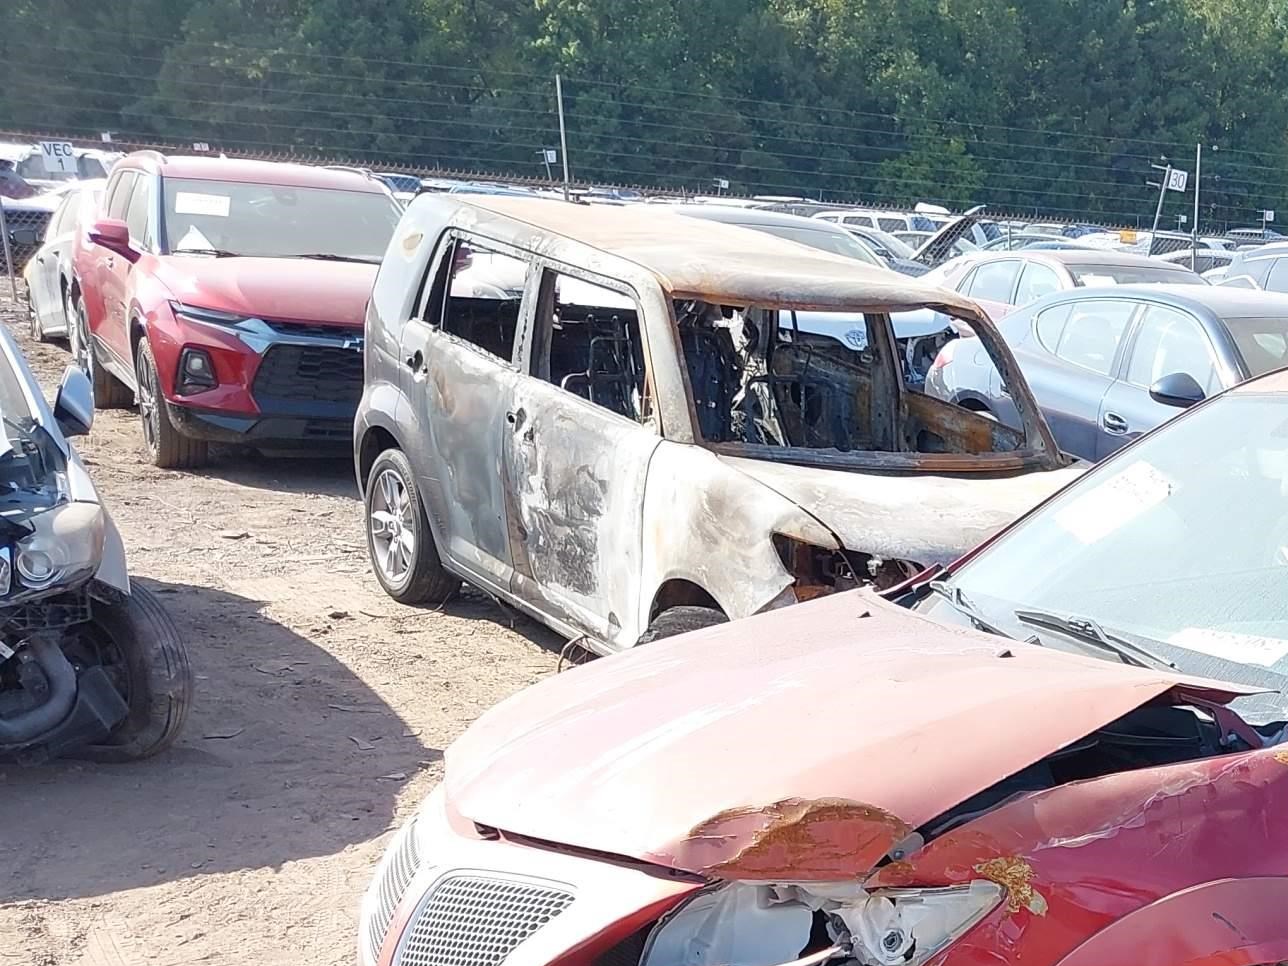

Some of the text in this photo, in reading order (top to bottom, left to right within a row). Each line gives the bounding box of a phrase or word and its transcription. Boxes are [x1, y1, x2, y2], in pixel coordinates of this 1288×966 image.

[42, 143, 73, 157] VEC
[57, 158, 65, 171] 1
[1170, 172, 1185, 189] 30
